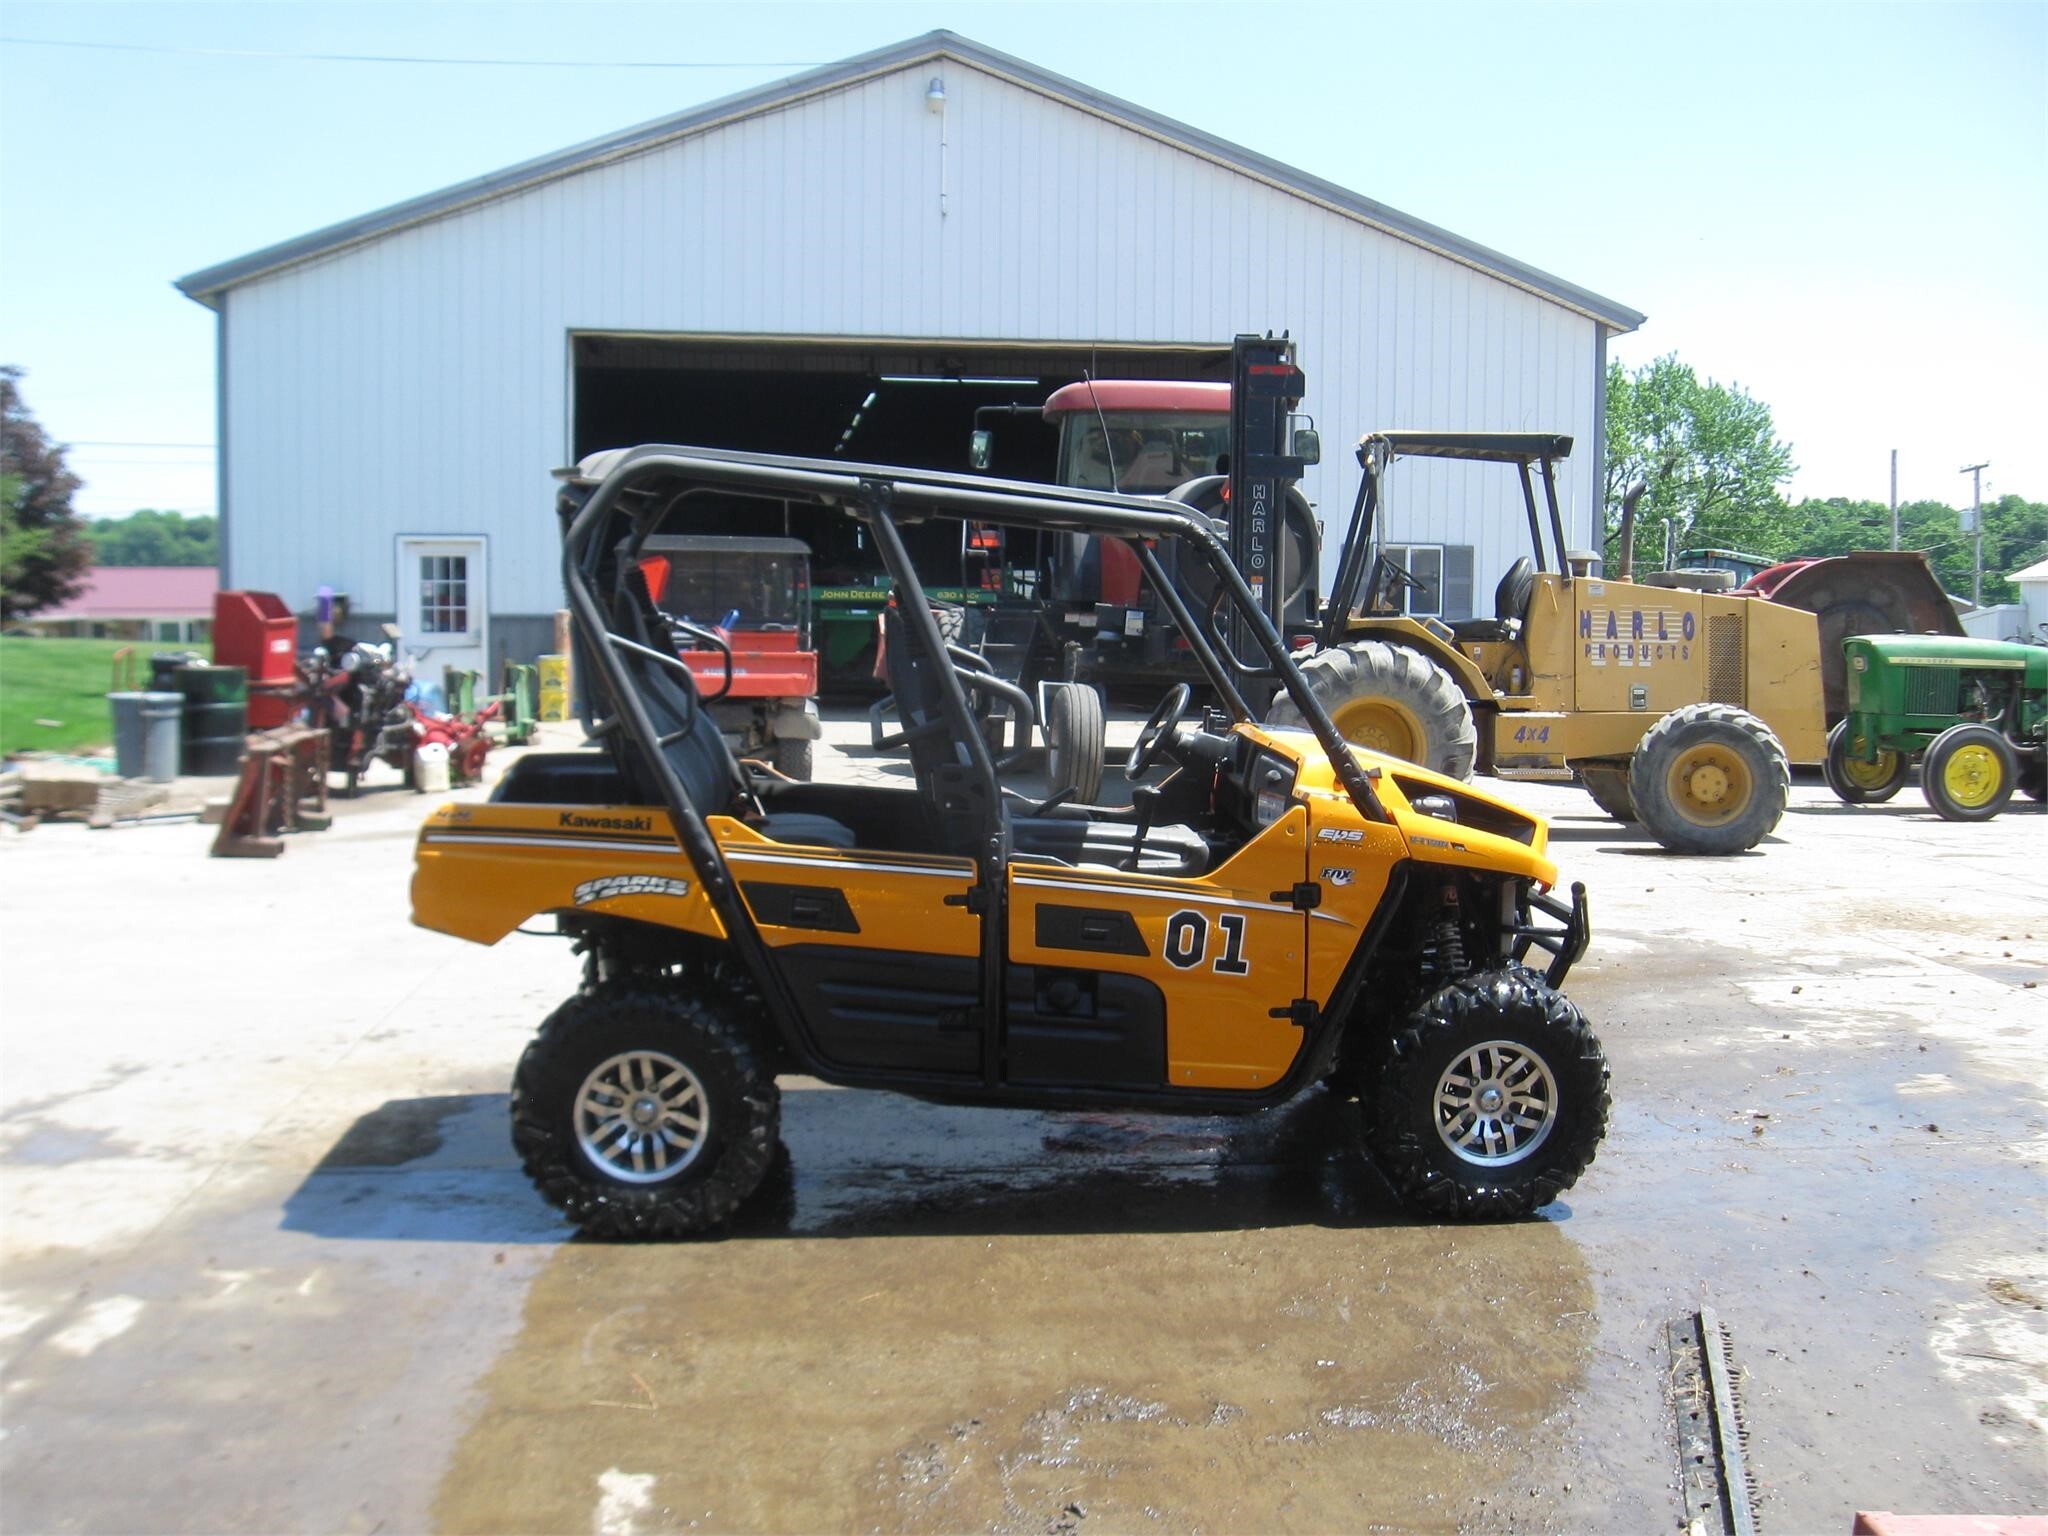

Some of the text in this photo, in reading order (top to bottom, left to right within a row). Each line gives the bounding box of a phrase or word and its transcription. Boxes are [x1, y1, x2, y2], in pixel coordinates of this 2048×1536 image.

[1251, 484, 1266, 569] HARLO
[820, 590, 885, 600] JOHN DEERE
[1579, 608, 1695, 641] HARLO
[1584, 643, 1689, 660] PRODUCTS
[559, 812, 652, 832] Kawasaki
[573, 873, 689, 899] SPARKS
[1320, 867, 1355, 885] FOX
[597, 884, 688, 899] SONS
[1163, 908, 1250, 977] 01
